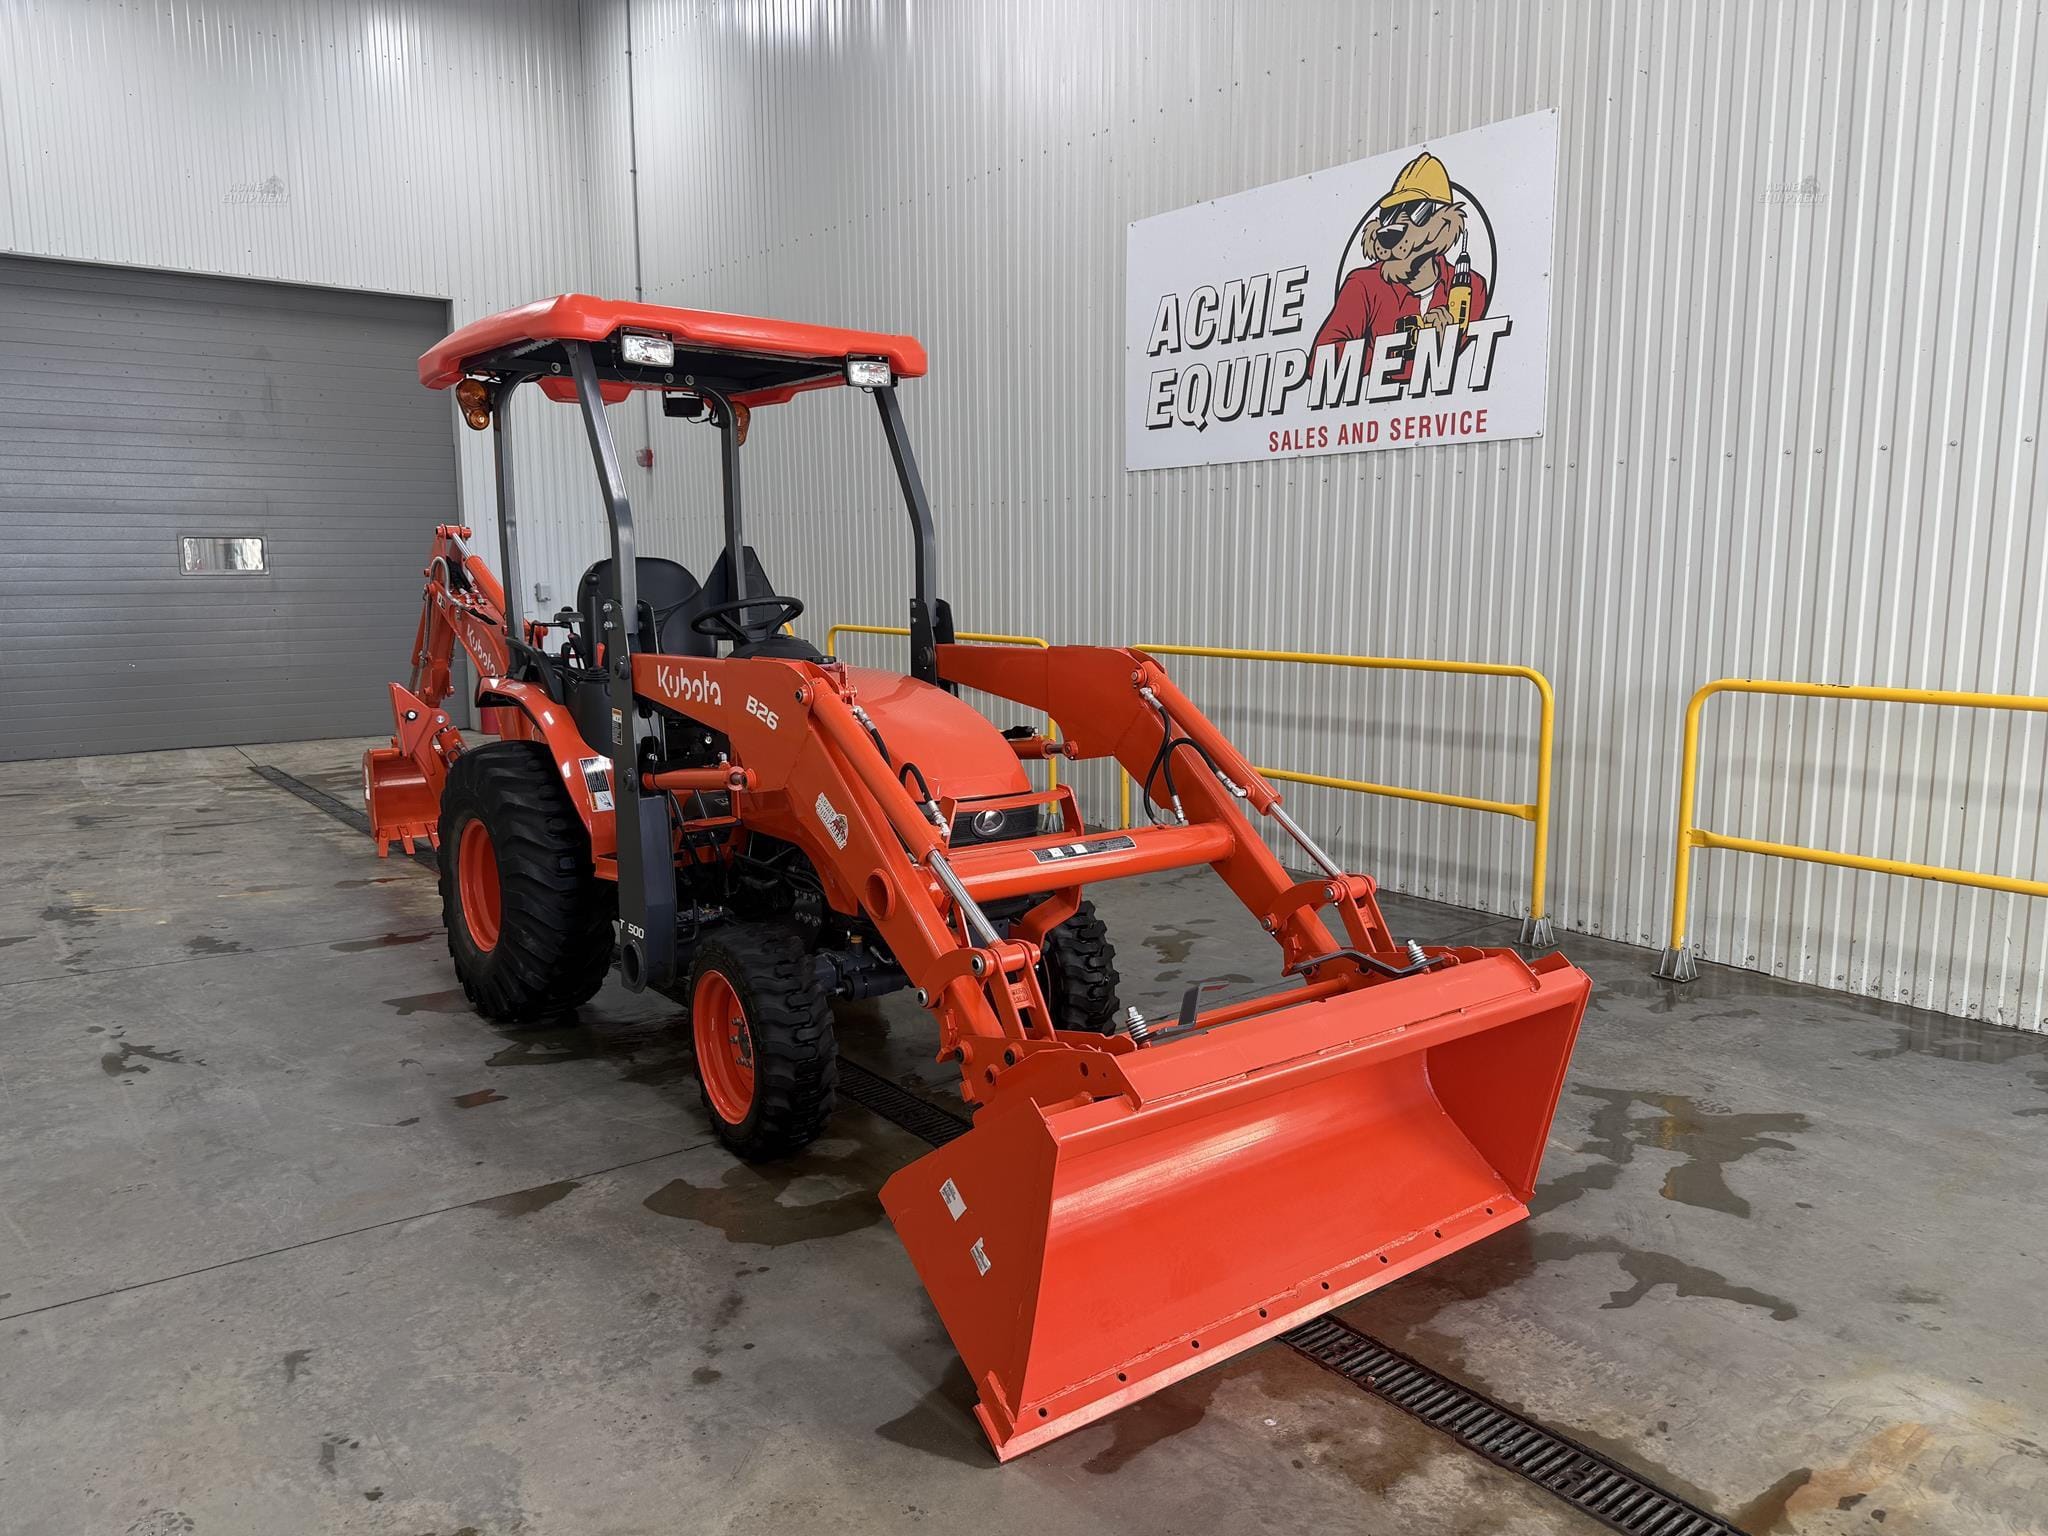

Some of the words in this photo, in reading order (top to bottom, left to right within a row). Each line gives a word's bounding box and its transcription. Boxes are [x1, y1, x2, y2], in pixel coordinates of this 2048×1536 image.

[1146, 265, 1309, 358] ACME
[1146, 315, 1513, 432] EQUIPMENT
[1269, 427, 1328, 452] SALES
[1338, 421, 1379, 446] AND
[1389, 409, 1488, 441] SERVICE
[467, 624, 499, 679] Kubota
[657, 665, 722, 706] Kubota
[745, 694, 779, 730] B26
[628, 923, 645, 939] 500
